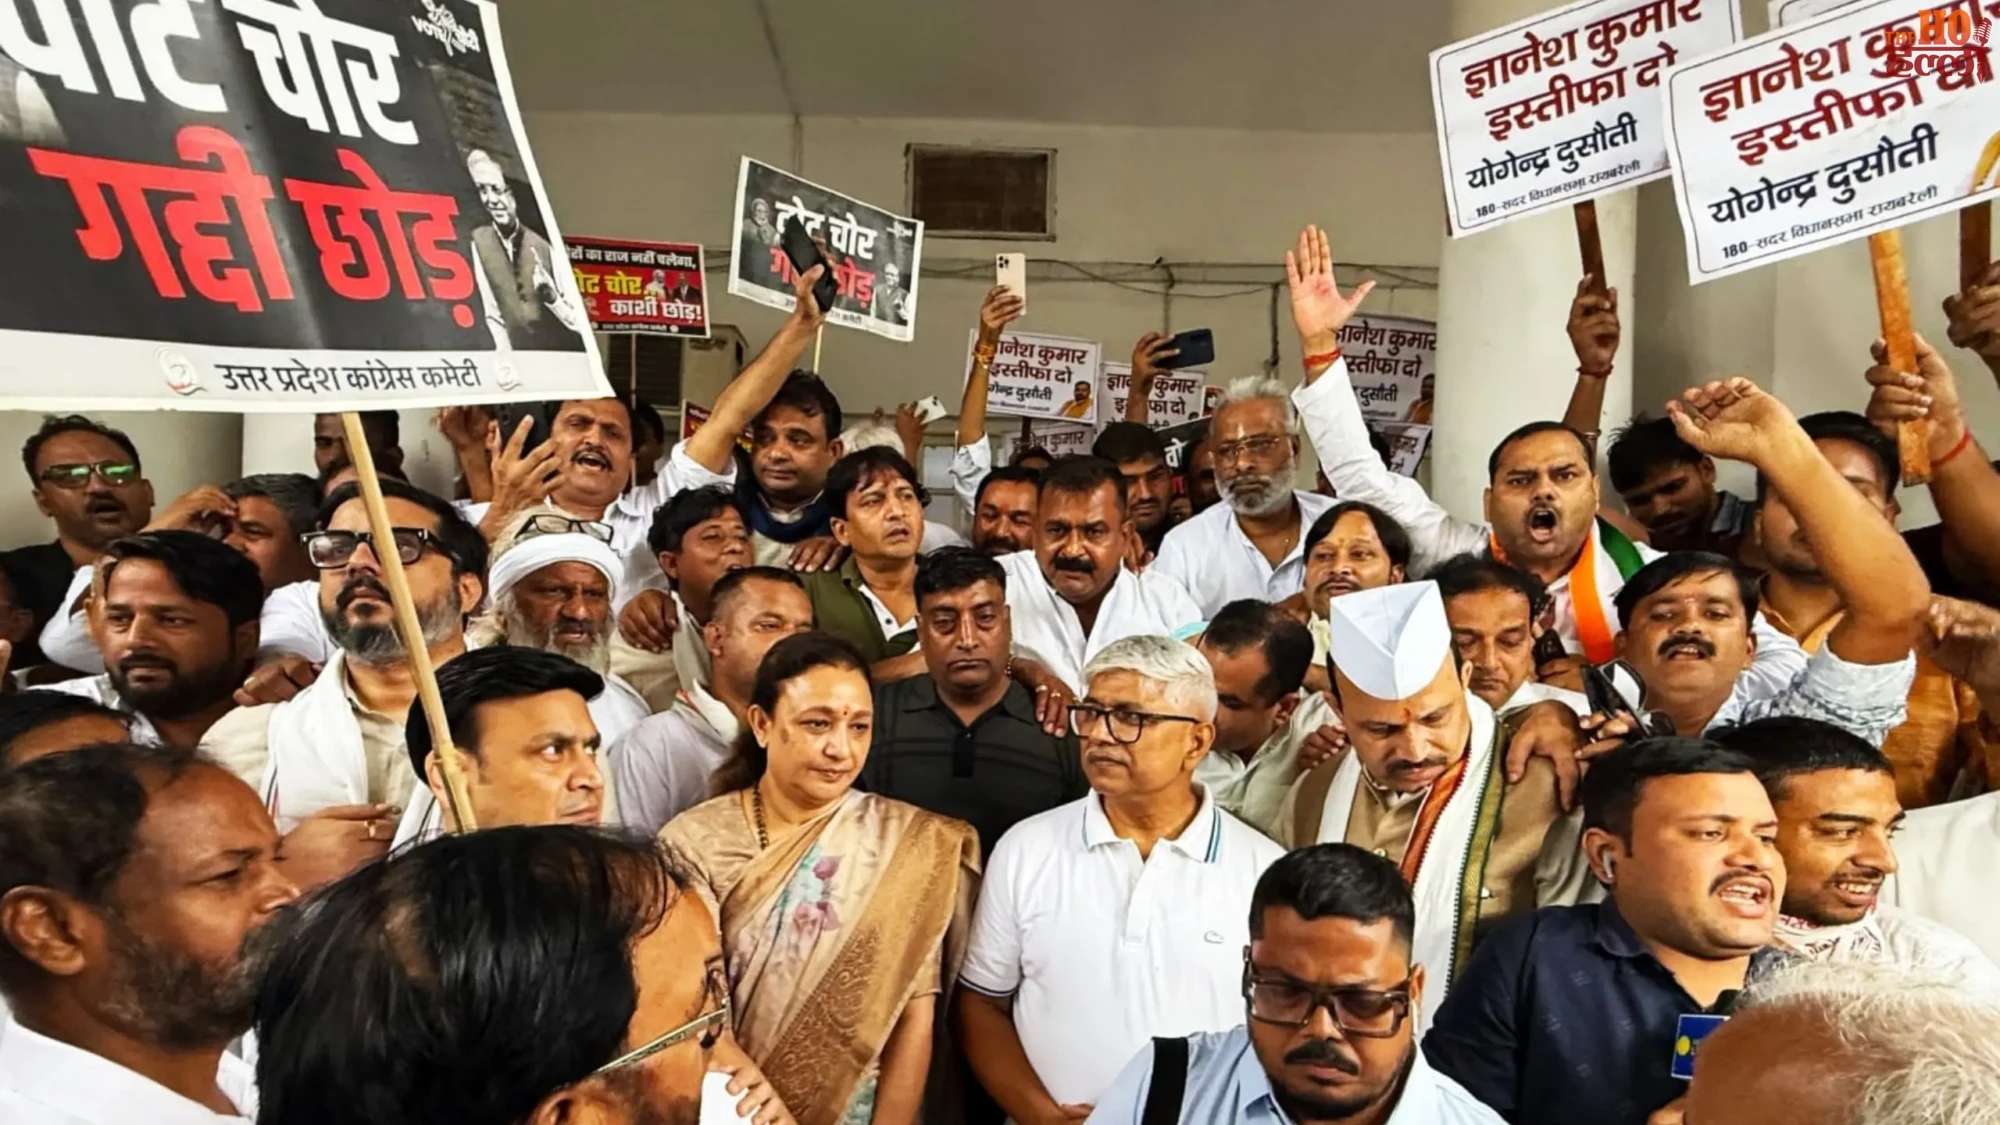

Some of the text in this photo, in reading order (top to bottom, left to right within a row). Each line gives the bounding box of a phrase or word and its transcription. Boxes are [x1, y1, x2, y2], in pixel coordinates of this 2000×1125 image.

[223, 0, 418, 145] चोर
[1461, 0, 1702, 99] ज्ञानेश कुमार
[1700, 0, 2000, 123] ज्ञानेश कुमा
[1485, 73, 1627, 141] इस्तीफा
[1731, 88, 1923, 166] इस्तीफा
[1466, 111, 1638, 189] योगेन्द्र दुसौती
[1708, 122, 1939, 224] योगेन्द्र दुसौती
[26, 125, 474, 328] गद्दी छोड़
[828, 212, 878, 260] चोर
[573, 268, 601, 293] ोट
[609, 294, 657, 317] काशी
[214, 358, 482, 394] उत्तर प्रदेश कांग्रेस कमेटी
[1038, 344, 1088, 366] कुमार
[1054, 366, 1072, 383] दो
[1343, 349, 1422, 377] स्तीफा दो
